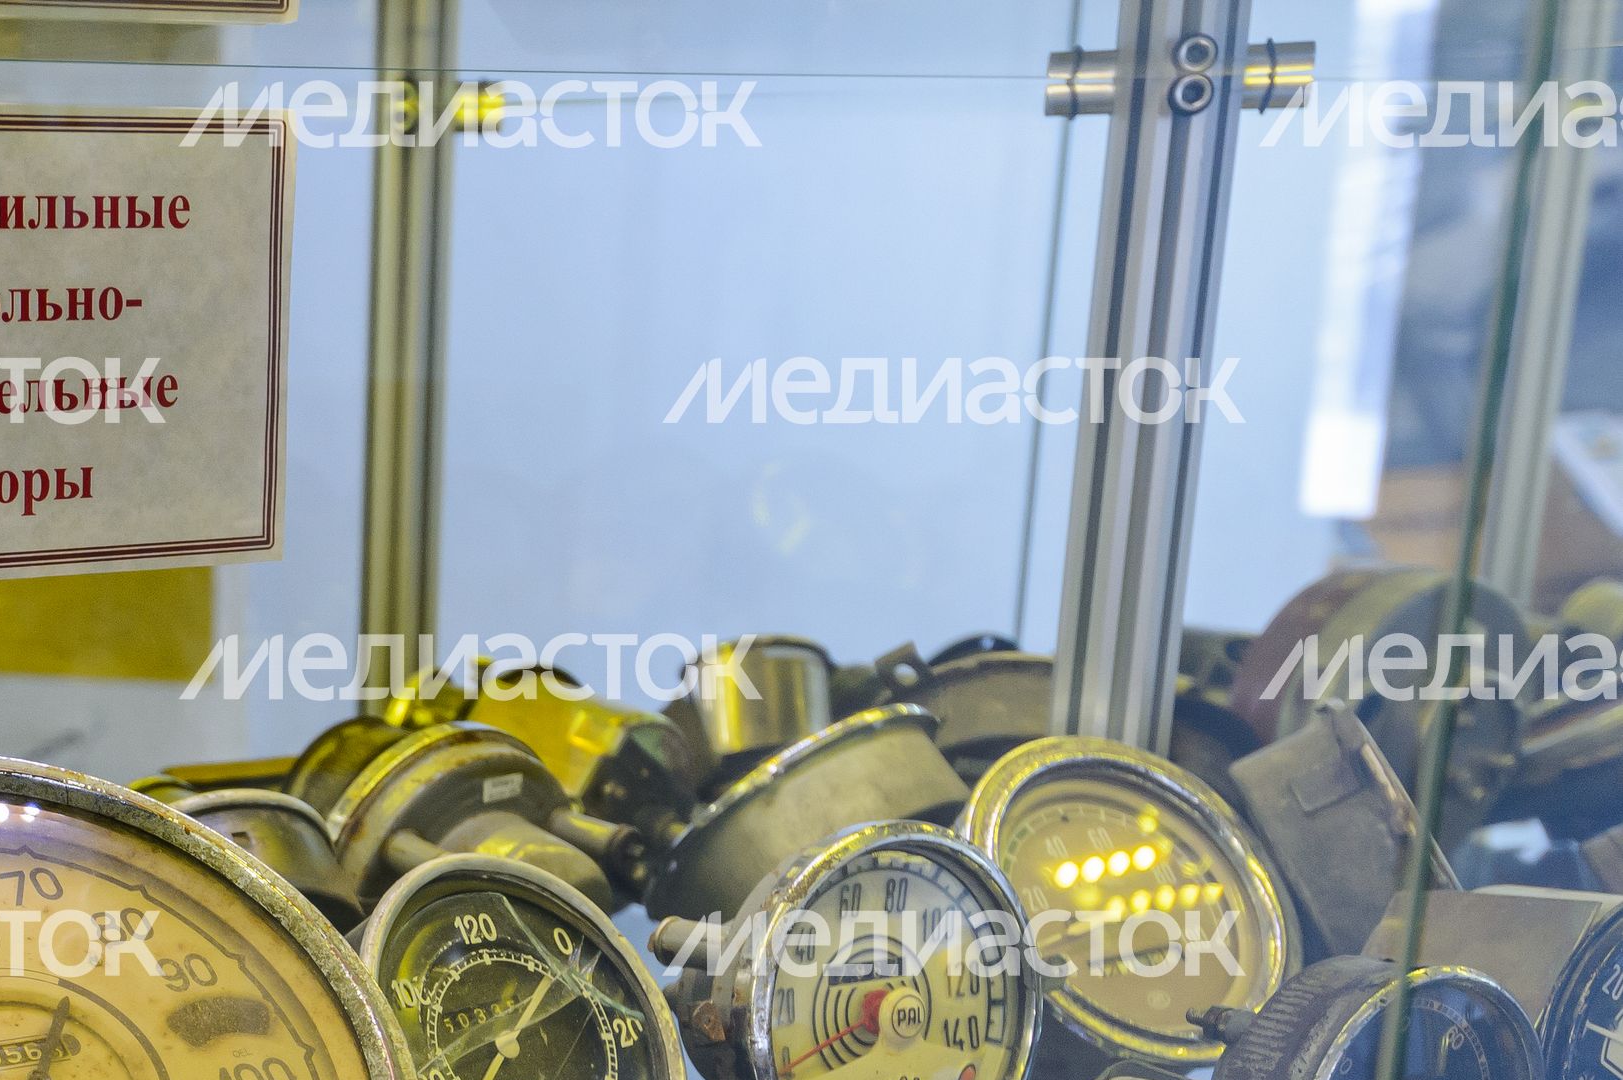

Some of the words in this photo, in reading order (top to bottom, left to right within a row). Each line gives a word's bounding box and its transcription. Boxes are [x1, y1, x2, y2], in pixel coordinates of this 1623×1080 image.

[839, 882, 863, 919] 60
[884, 876, 910, 914] 80
[91, 907, 156, 945] 80
[453, 911, 499, 946] 120
[553, 926, 574, 956] 0
[156, 953, 219, 993] 90
[896, 1005, 923, 1028] PAL
[943, 1014, 982, 1052] 140
